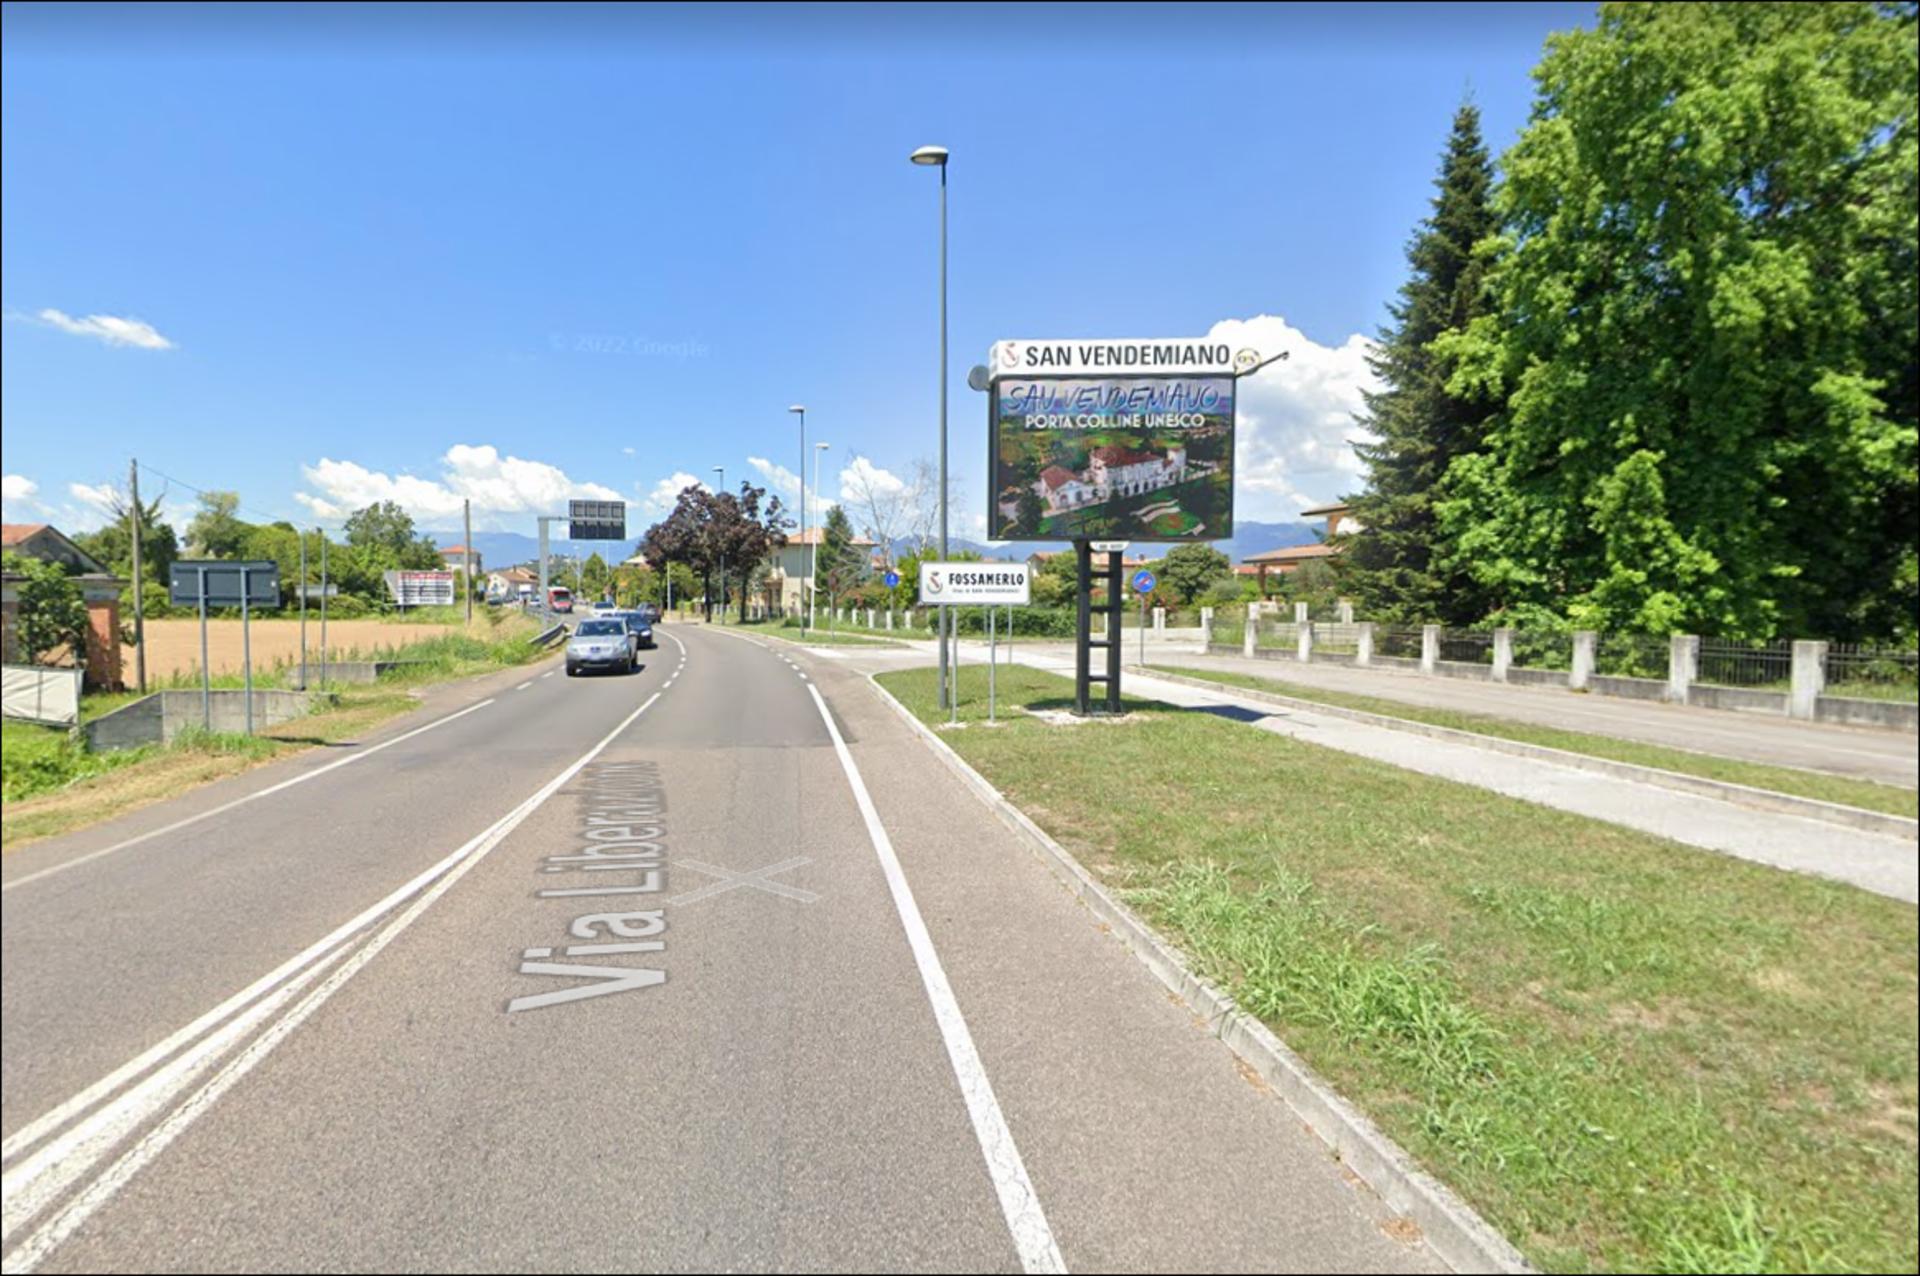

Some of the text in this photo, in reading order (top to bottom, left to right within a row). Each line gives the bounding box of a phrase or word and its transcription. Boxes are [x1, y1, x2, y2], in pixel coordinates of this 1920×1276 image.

[1025, 345, 1071, 367] SAN
[1079, 344, 1230, 367] VENDEMIANO
[1007, 383, 1219, 413] SAN VENDEMIANO
[1025, 412, 1206, 429] PORTA COLLINE UNESCO
[948, 573, 1024, 586] FOSSAMERLO
